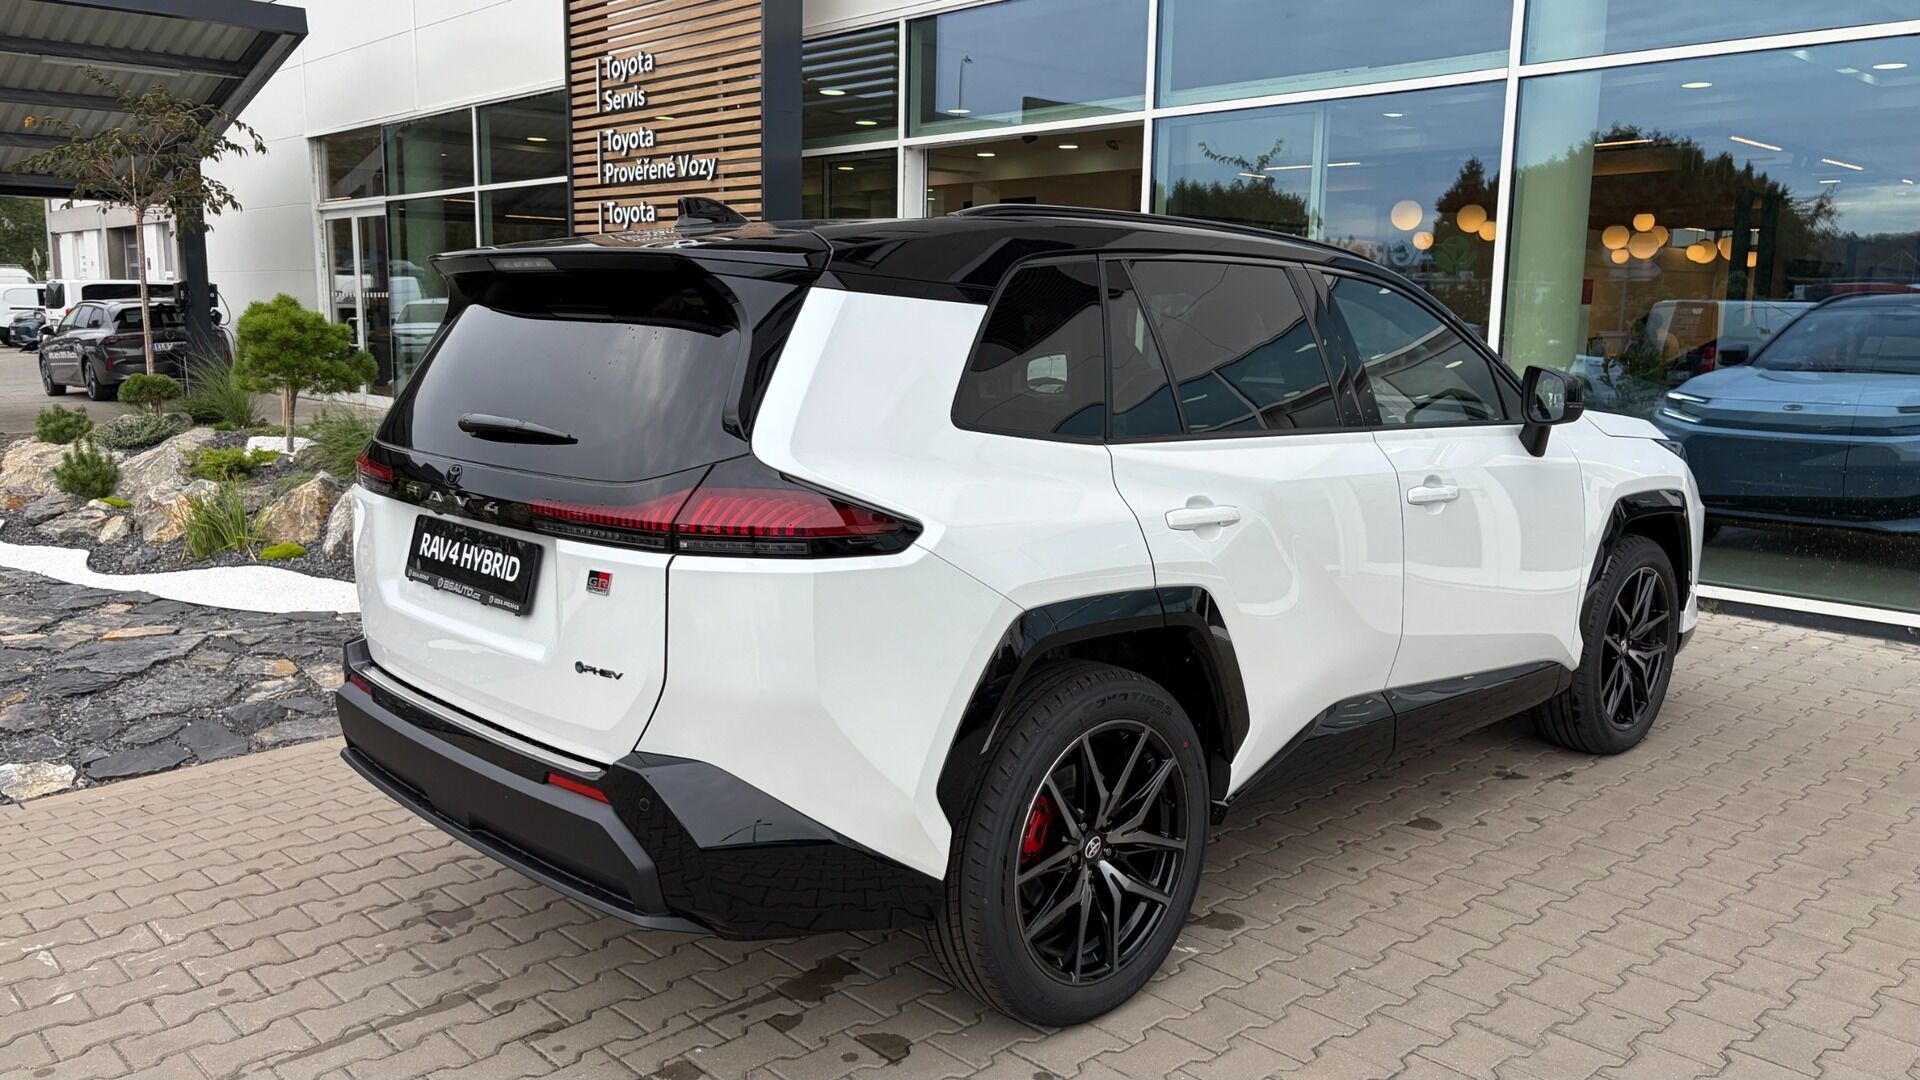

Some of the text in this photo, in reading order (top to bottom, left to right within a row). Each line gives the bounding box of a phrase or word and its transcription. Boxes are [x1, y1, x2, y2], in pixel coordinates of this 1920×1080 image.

[604, 51, 653, 82] Toyota
[605, 84, 646, 112] Servis
[605, 126, 655, 157] Toyota
[605, 154, 716, 184] Prověřené Vozy
[606, 201, 656, 230] Toyota
[419, 532, 521, 582] RAV4 HYBRID
[588, 576, 609, 590] GR
[583, 664, 624, 681] PHEV
